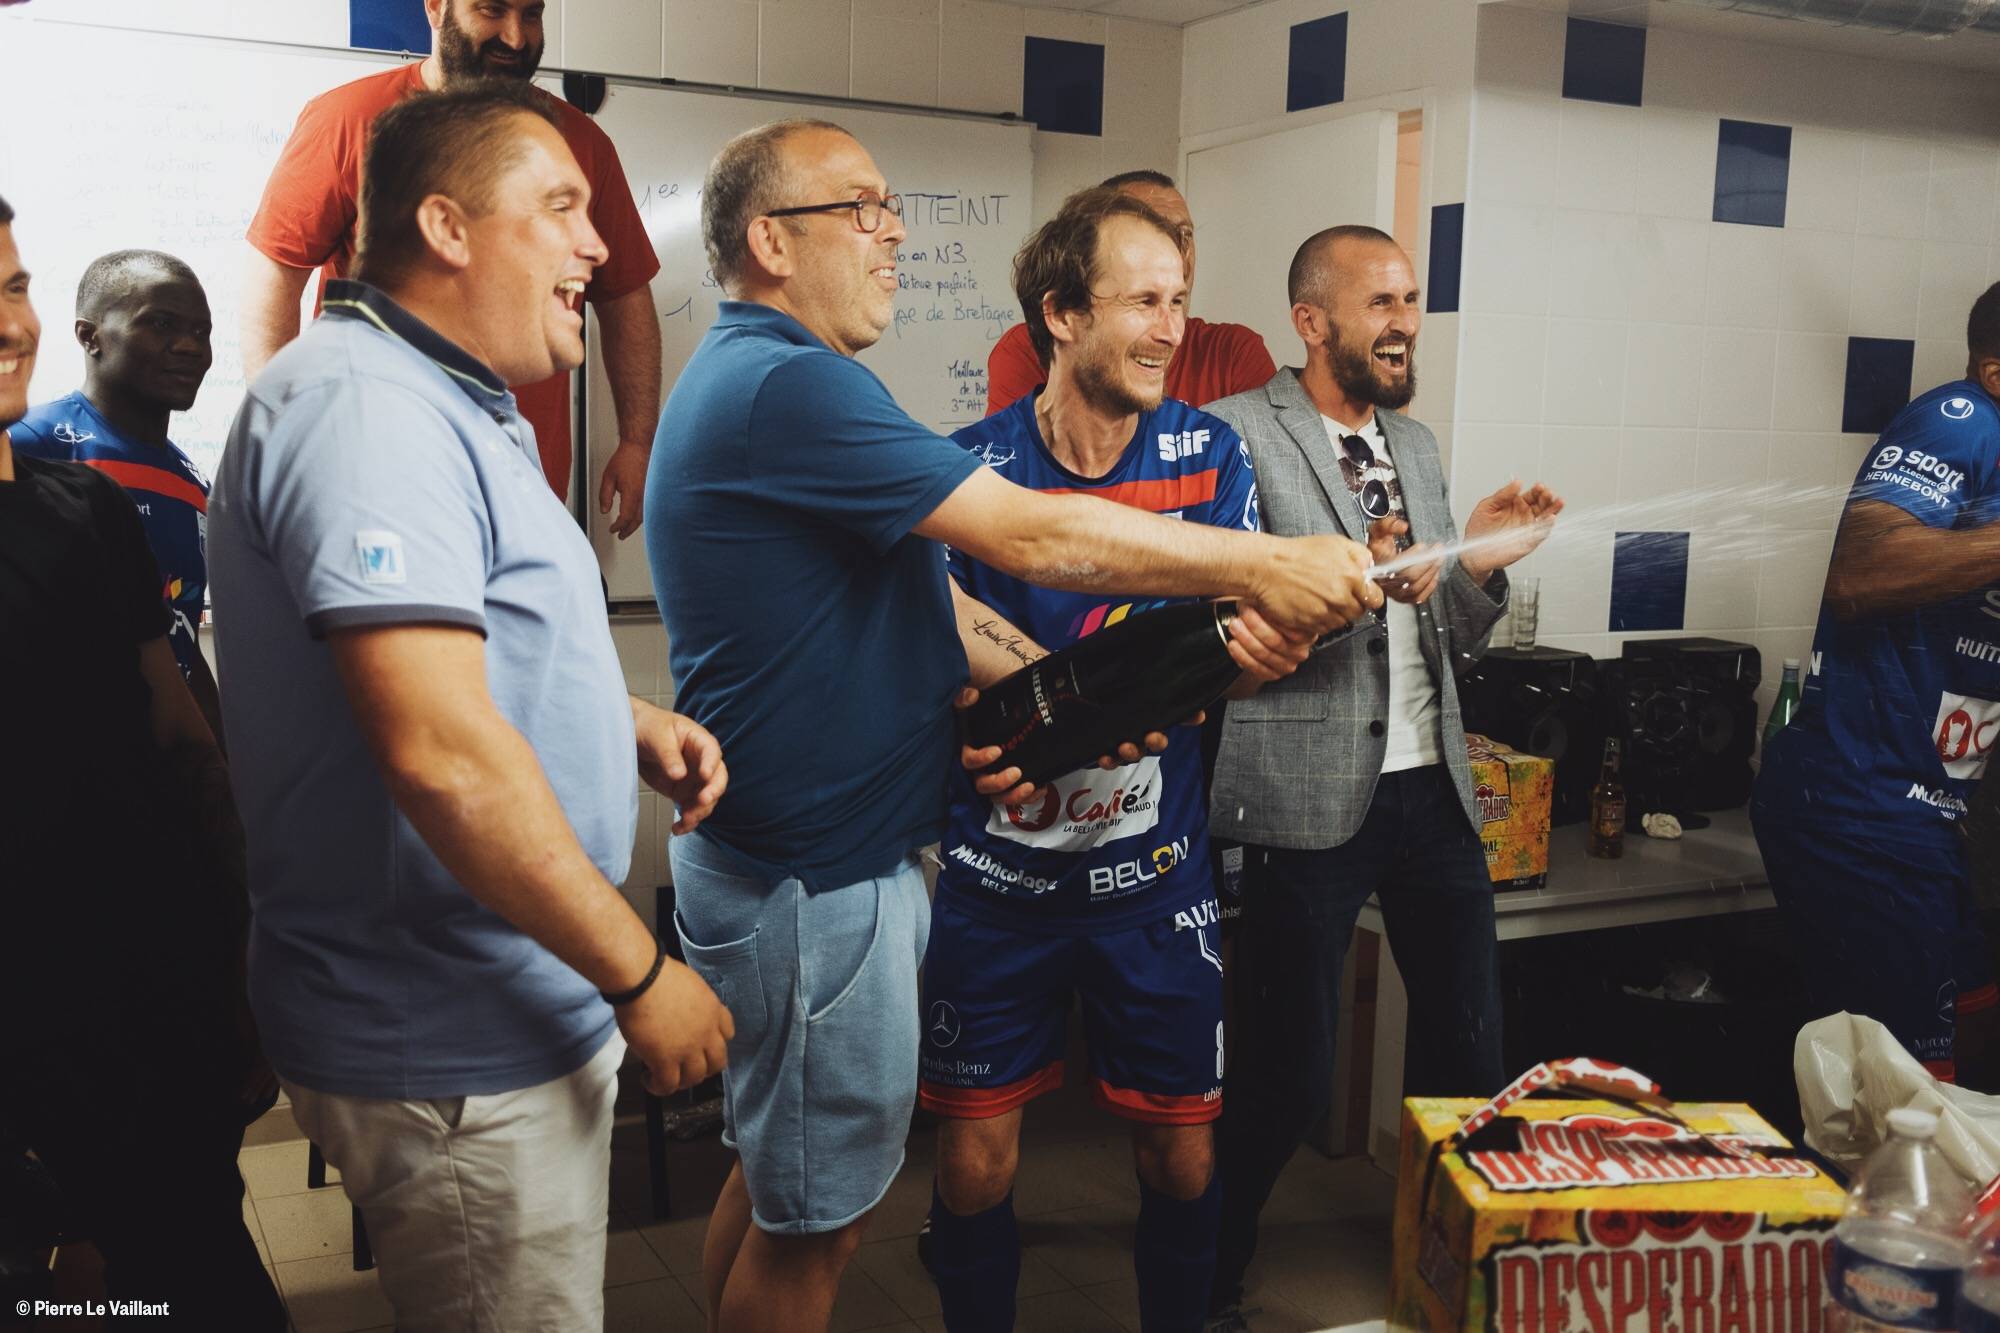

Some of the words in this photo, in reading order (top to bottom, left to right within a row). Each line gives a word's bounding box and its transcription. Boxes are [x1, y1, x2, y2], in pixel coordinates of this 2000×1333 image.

[953, 296, 1016, 340] Bretagne
[1864, 470, 1950, 508] HENNEBONT
[1905, 450, 1965, 490] sport
[981, 877, 1009, 895] BELZ
[1500, 1236, 1836, 1333] DESPERADO
